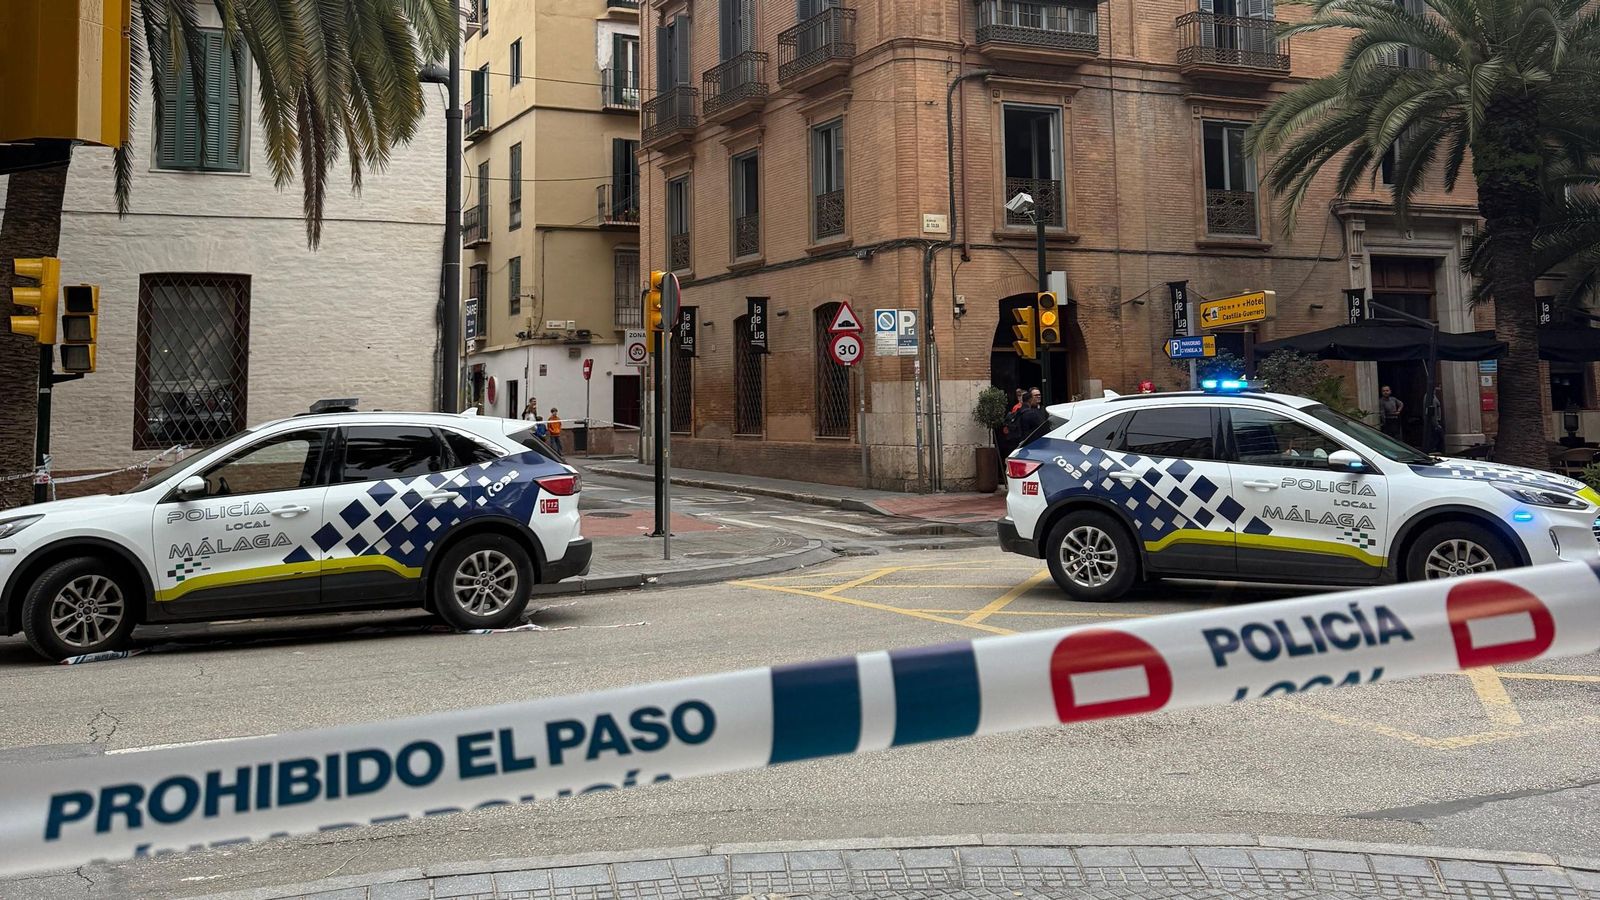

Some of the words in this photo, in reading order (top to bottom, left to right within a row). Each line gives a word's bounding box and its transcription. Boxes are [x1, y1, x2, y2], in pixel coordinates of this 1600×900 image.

[1246, 297, 1264, 307] Hotel
[1222, 312, 1241, 320] Castilla
[838, 344, 857, 356] 30
[1281, 477, 1377, 497] POLICÍA
[167, 501, 271, 524] POLICÍA
[1333, 499, 1376, 510] LOCAL
[226, 520, 271, 531] LOCAL
[1261, 505, 1376, 530] MÁLAGA
[169, 532, 293, 559] MÁLAGA
[1202, 602, 1415, 668] POLICÍA
[44, 740, 445, 842] PROHIBIDO
[456, 727, 537, 780] EL
[545, 699, 716, 766] PASO
